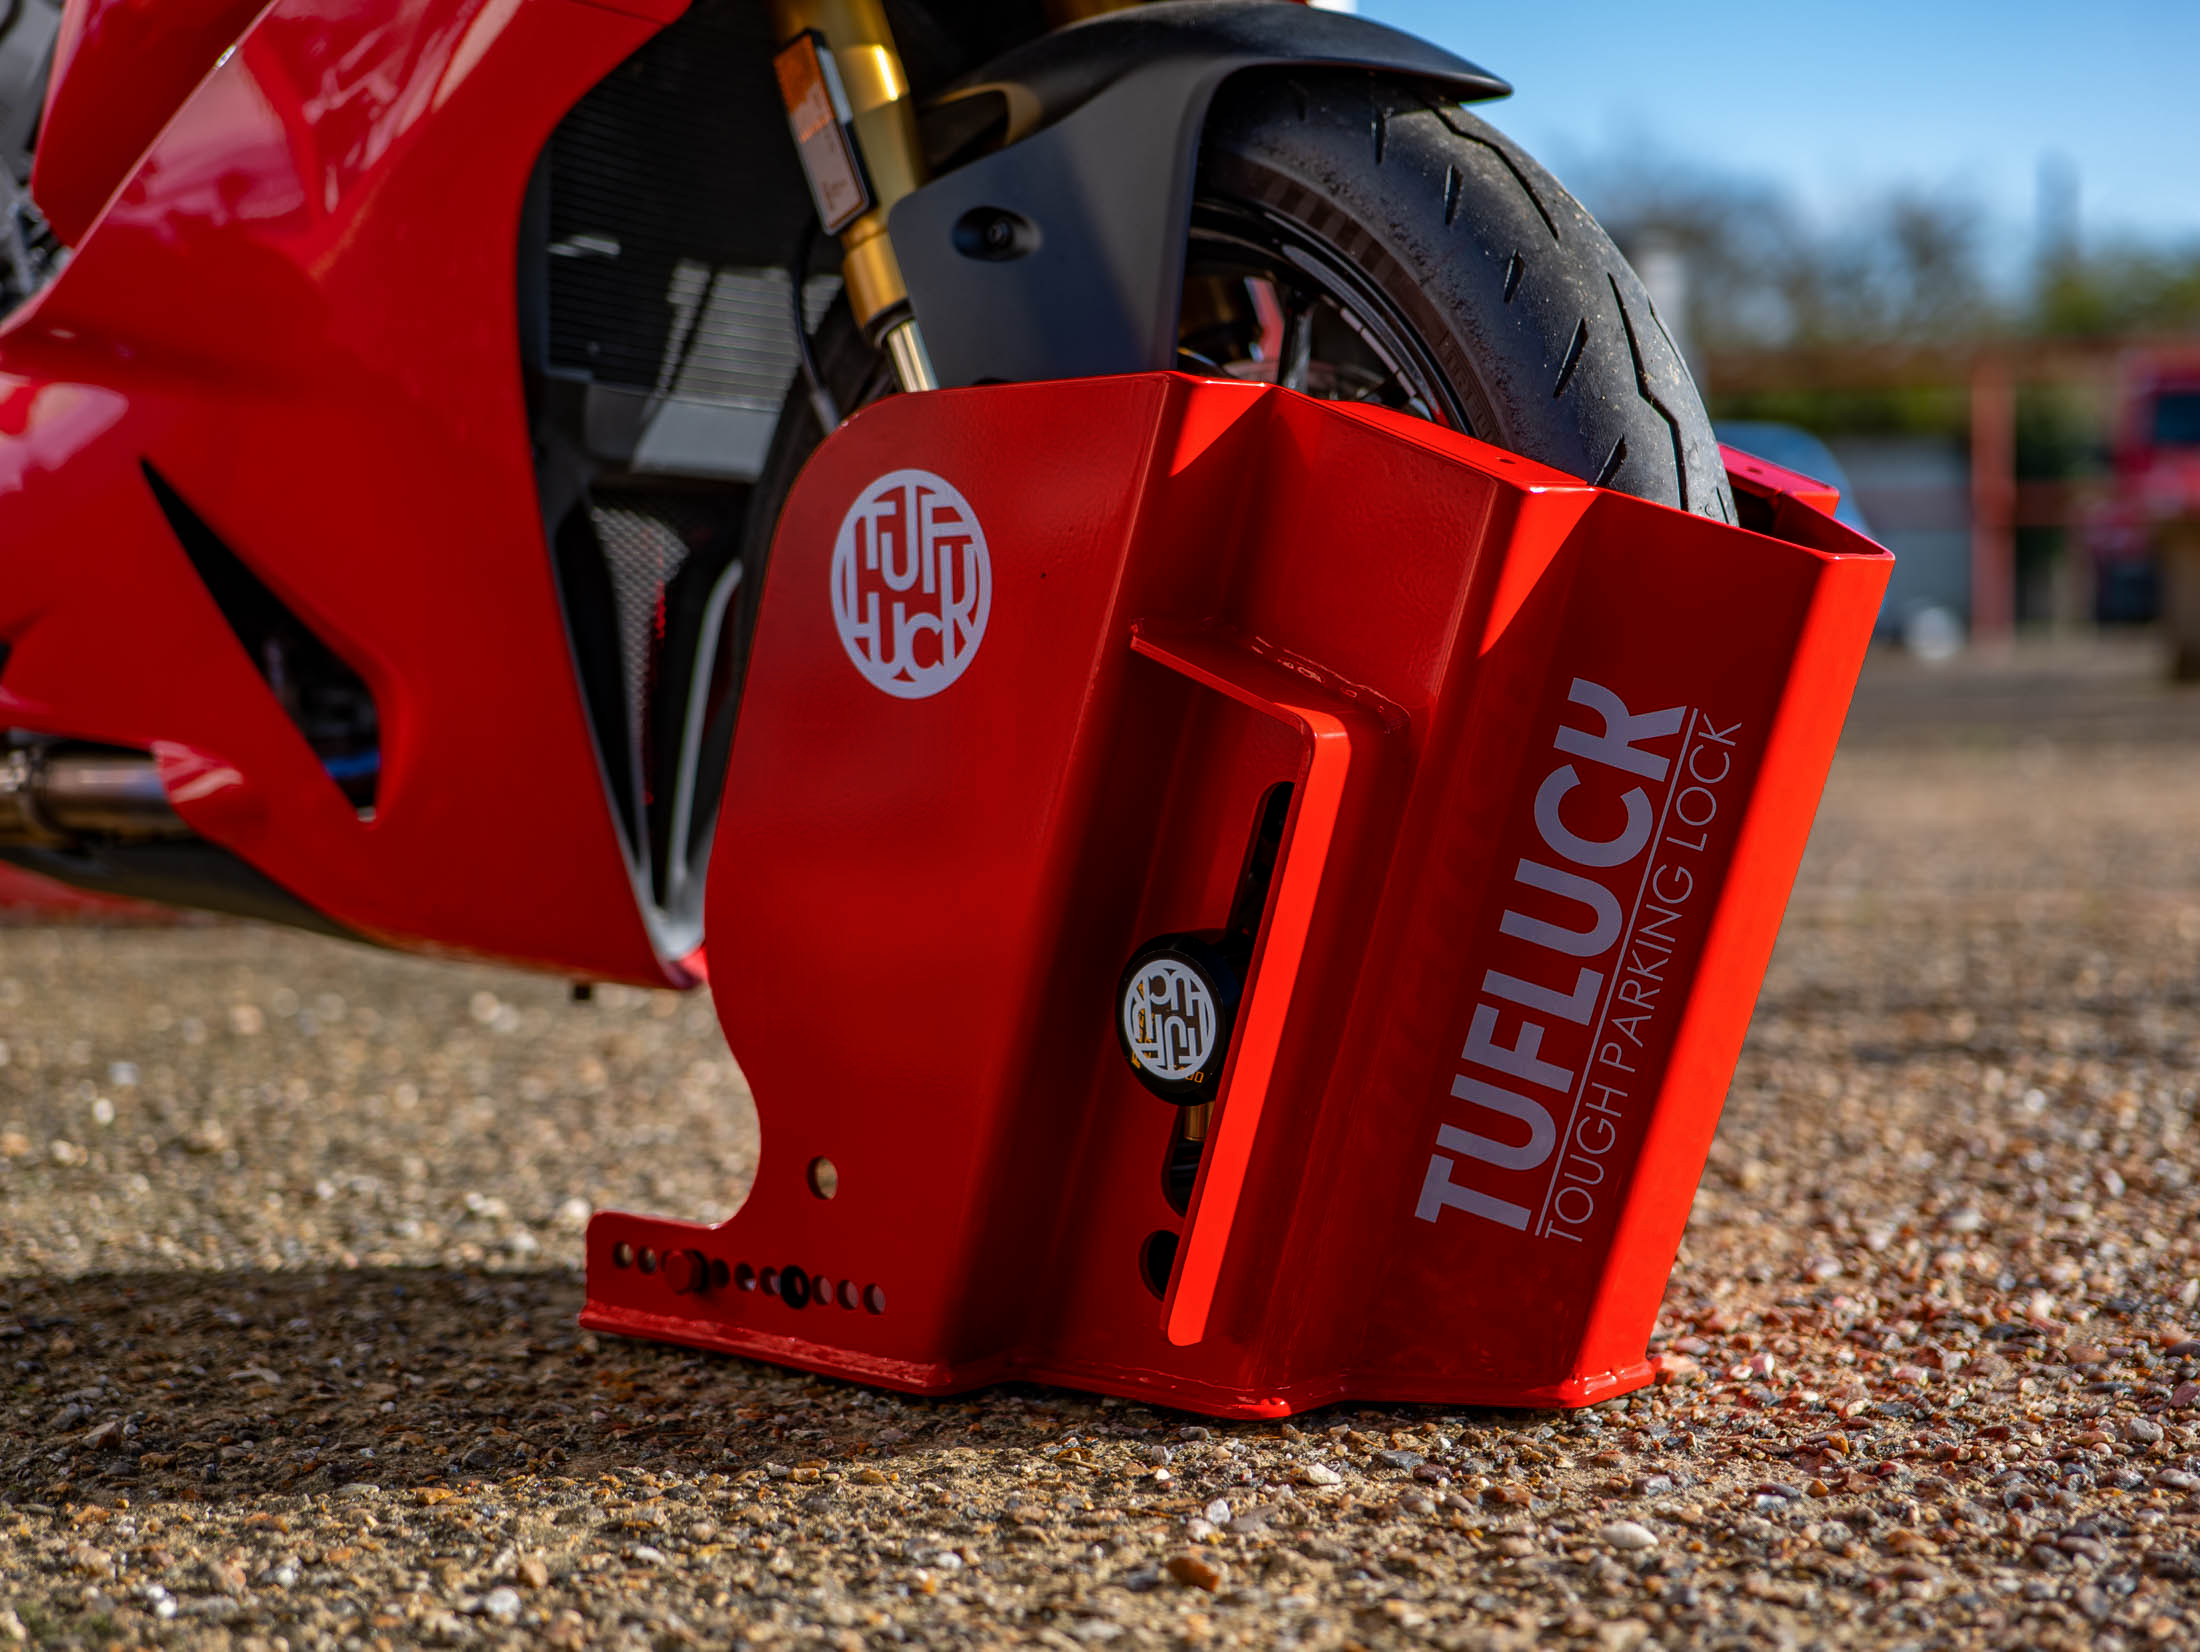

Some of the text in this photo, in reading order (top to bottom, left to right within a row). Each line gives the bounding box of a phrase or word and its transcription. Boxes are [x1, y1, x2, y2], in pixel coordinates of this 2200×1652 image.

[1414, 677, 1687, 1231] TUFLUCK
[1544, 713, 1742, 1242] TOUGH PARKING LOCK
